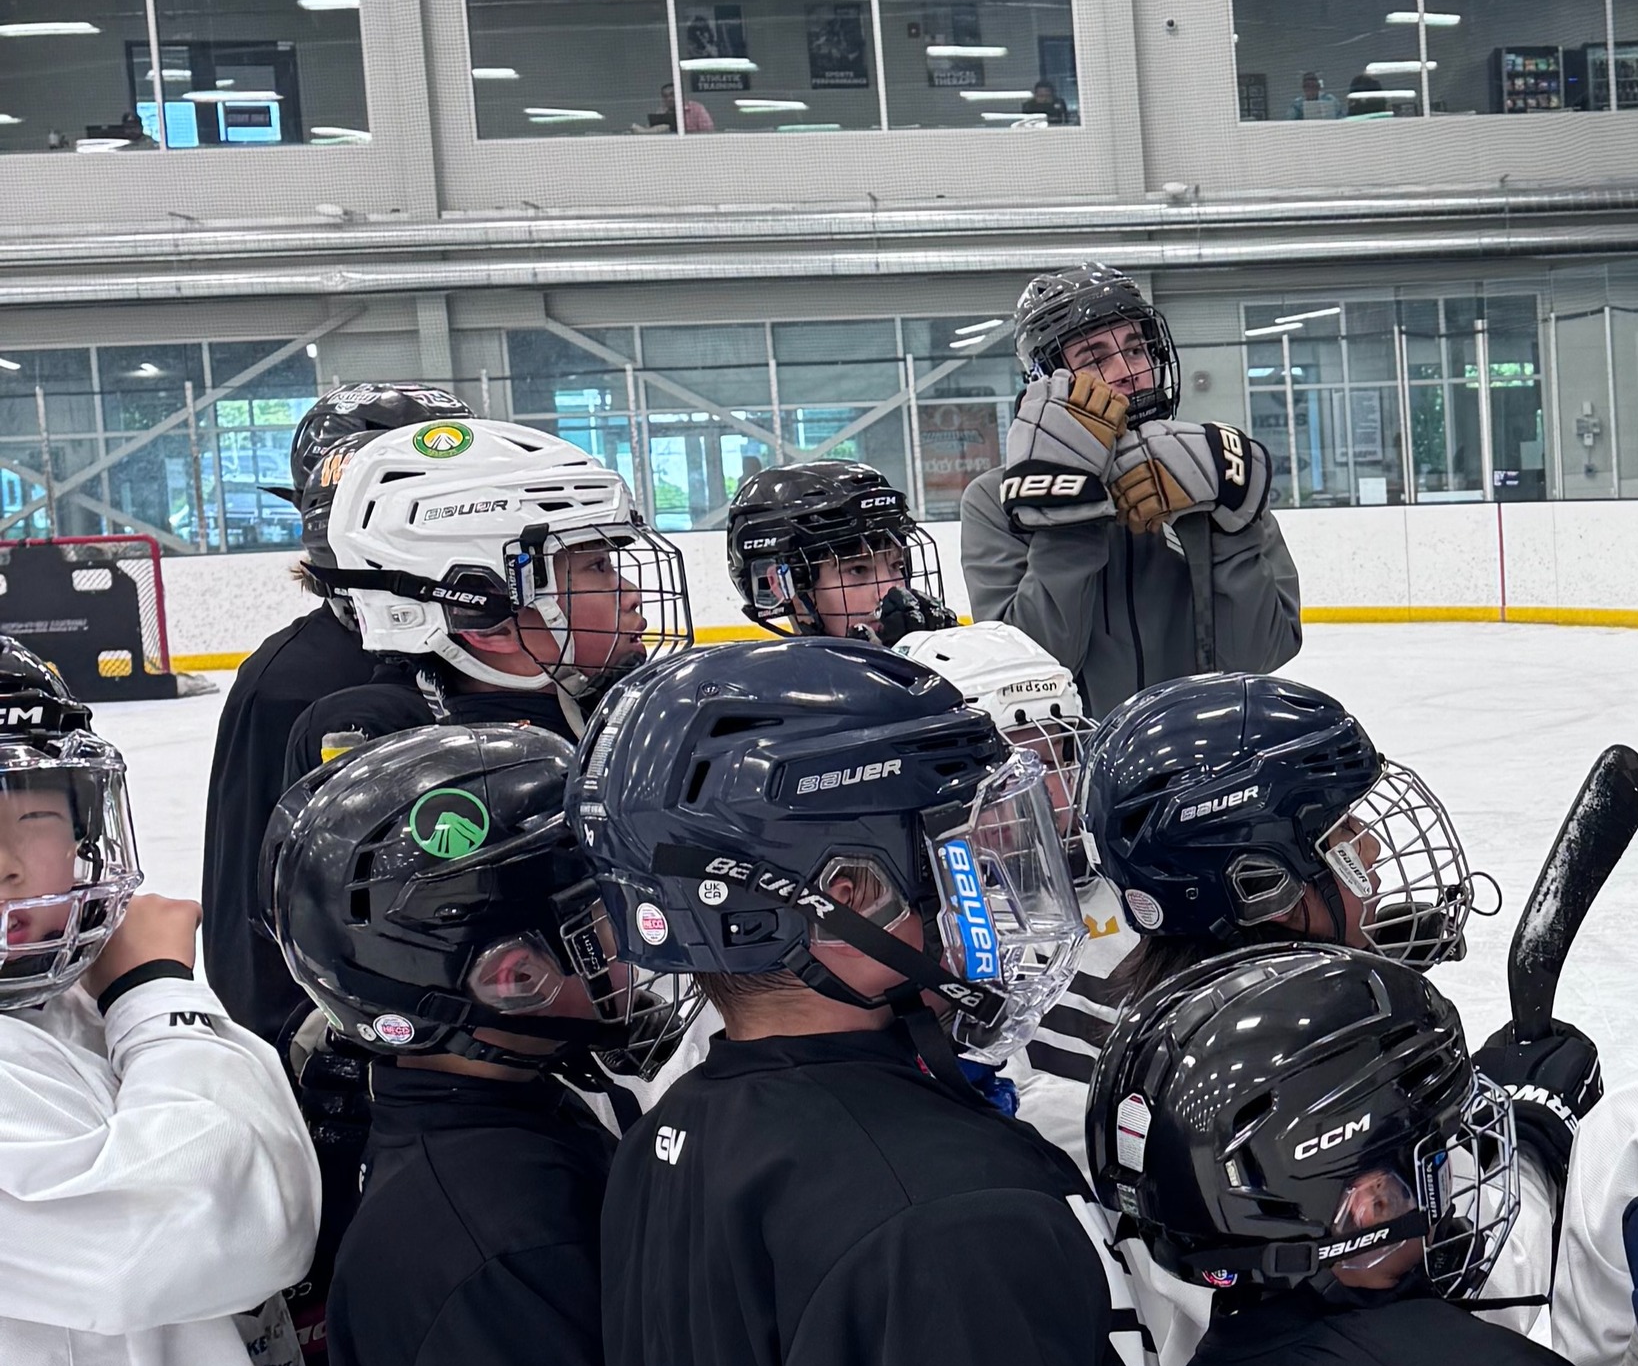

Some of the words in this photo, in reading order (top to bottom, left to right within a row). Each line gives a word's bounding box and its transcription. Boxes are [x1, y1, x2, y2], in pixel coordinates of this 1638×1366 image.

[424, 499, 509, 522] BAUER
[860, 496, 898, 510] CCM
[743, 537, 778, 550] CCM
[420, 585, 488, 607] AUER
[797, 758, 902, 795] BAUER
[1180, 785, 1259, 822] BAUER
[1336, 848, 1370, 884] BAUER
[704, 882, 721, 891] UK
[704, 890, 722, 899] CA
[947, 843, 995, 975] BAUER
[1294, 1113, 1371, 1161] CCM
[1317, 1228, 1390, 1260] BAUER
